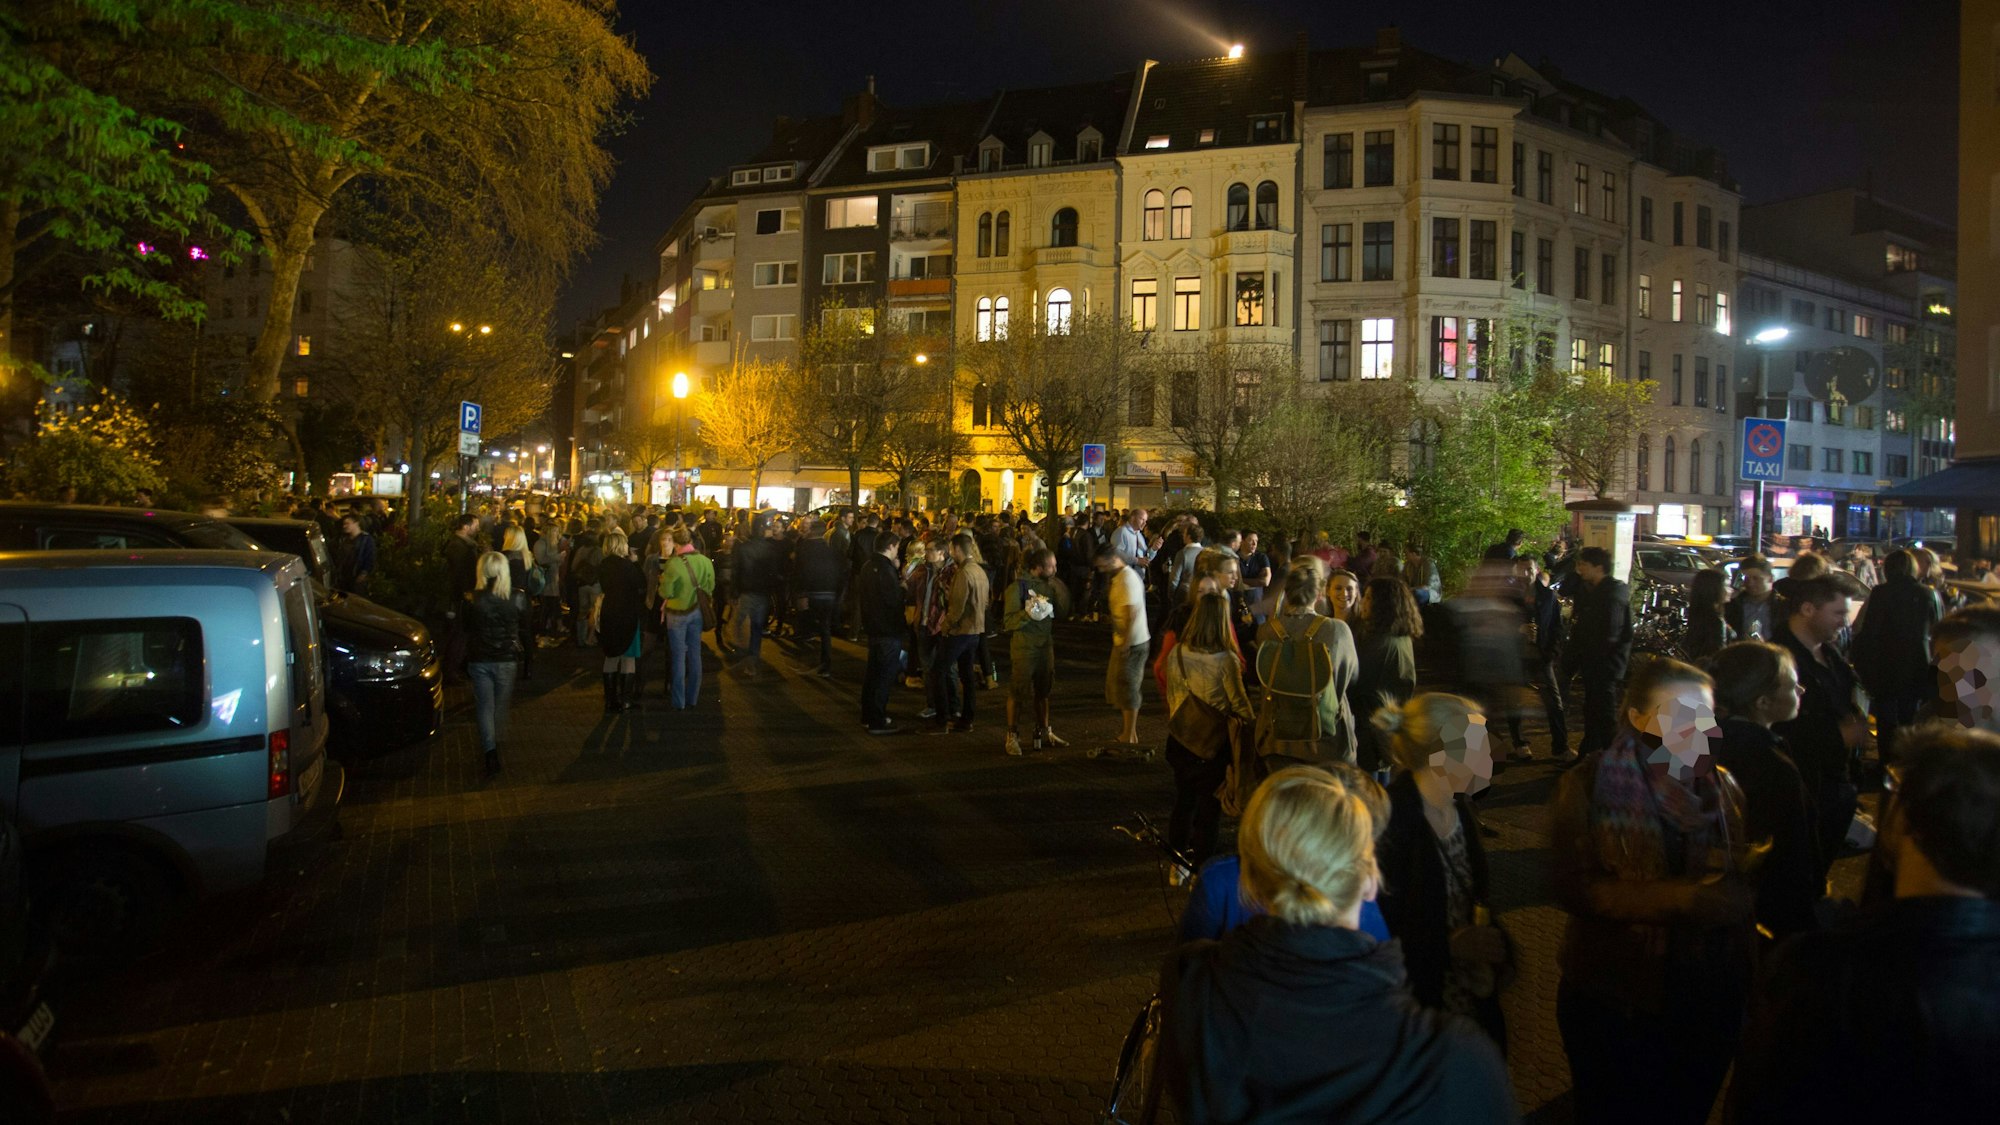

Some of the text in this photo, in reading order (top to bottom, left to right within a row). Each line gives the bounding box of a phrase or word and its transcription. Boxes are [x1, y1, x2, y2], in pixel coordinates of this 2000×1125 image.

[465, 406, 477, 429] P
[1085, 466, 1103, 475] TAXI
[1745, 460, 1780, 477] TAXI
